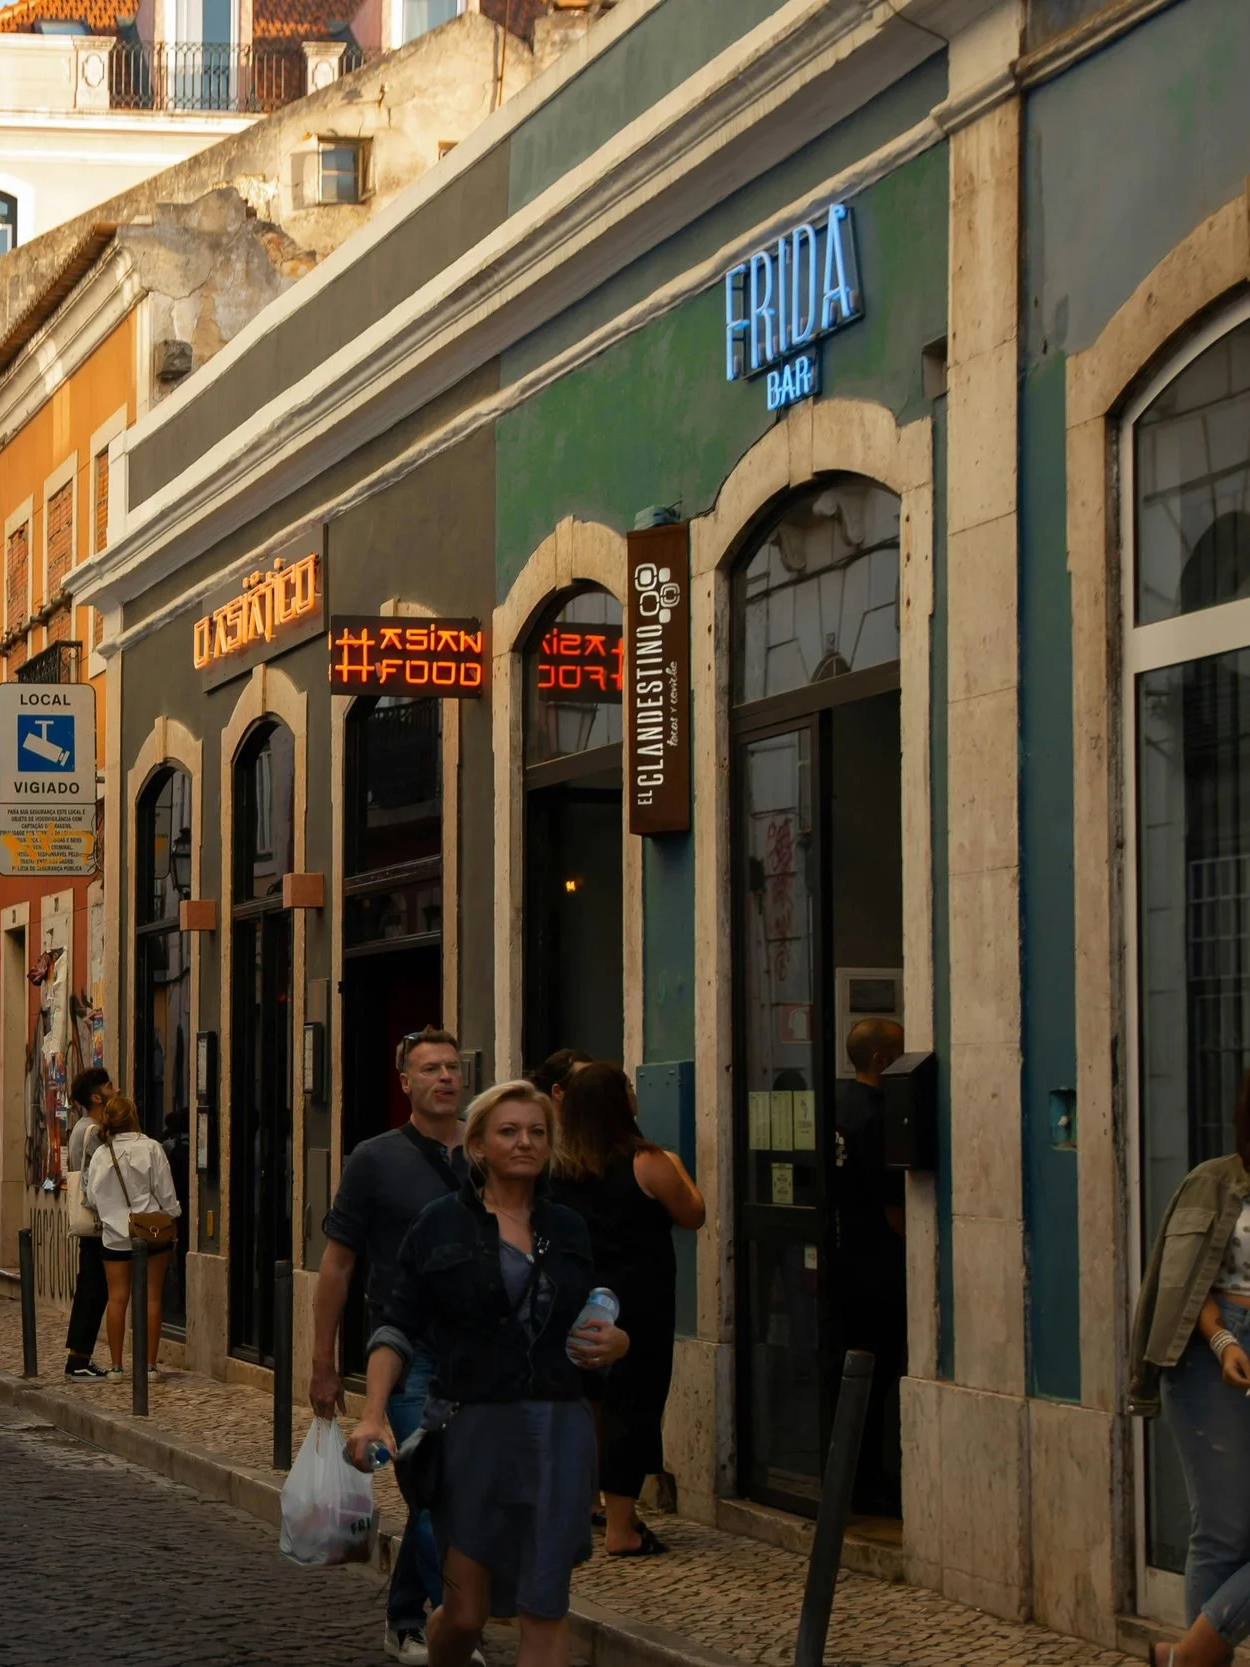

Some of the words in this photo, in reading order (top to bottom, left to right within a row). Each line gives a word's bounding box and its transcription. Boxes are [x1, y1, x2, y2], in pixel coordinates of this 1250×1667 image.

[725, 203, 850, 381] FRIDA
[766, 355, 811, 411] BAR
[379, 659, 482, 687] FOOD
[19, 693, 71, 706] LOCAL
[636, 624, 664, 787] CLANDESTINO
[13, 781, 80, 795] VIGIADO
[637, 790, 653, 805] EL
